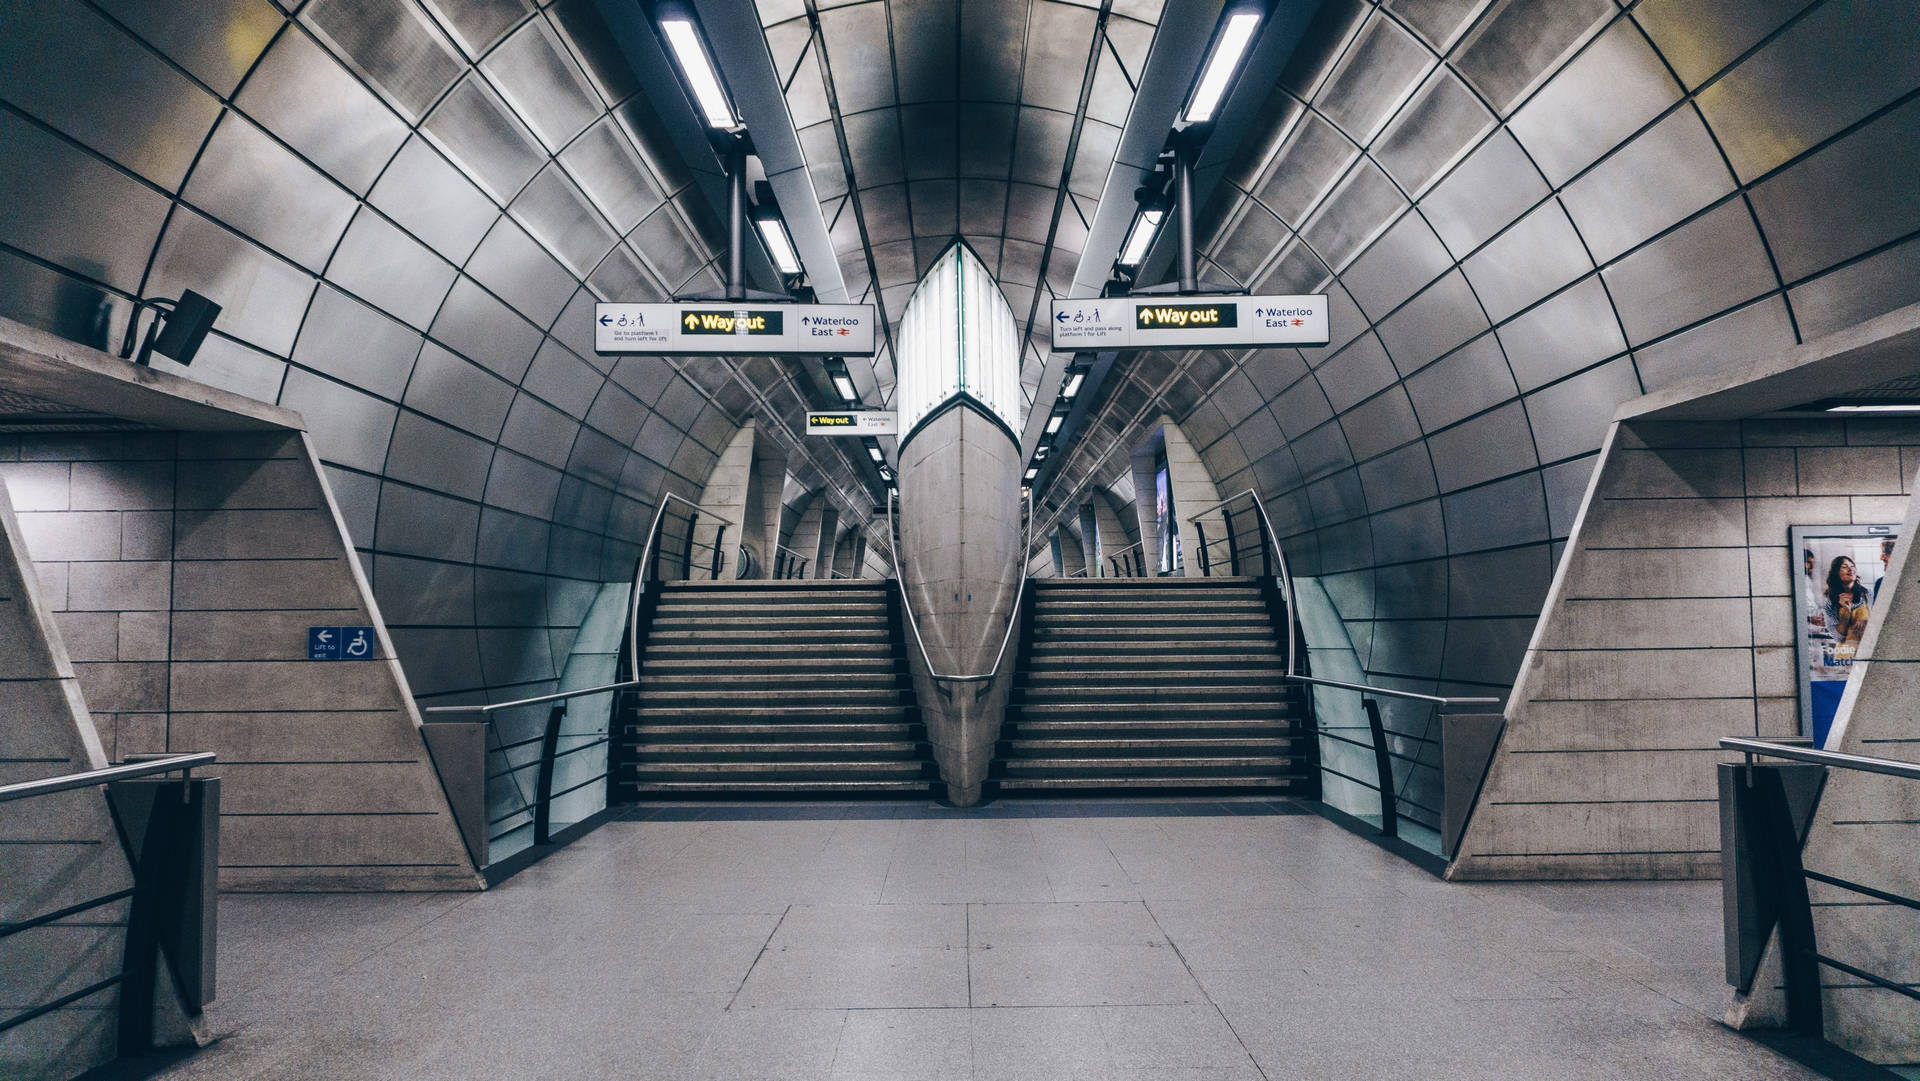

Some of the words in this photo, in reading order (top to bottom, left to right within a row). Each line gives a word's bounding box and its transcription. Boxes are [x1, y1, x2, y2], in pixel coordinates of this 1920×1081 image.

[1266, 308, 1313, 316] Waterloo
[812, 316, 859, 325] Waterloo
[1155, 308, 1188, 326] Way
[1190, 308, 1219, 322] out
[701, 314, 735, 332] Way
[736, 316, 766, 329] out
[1266, 319, 1287, 327] East
[811, 327, 833, 336] East
[819, 416, 835, 425] Way
[1821, 645, 1856, 655] Foodie
